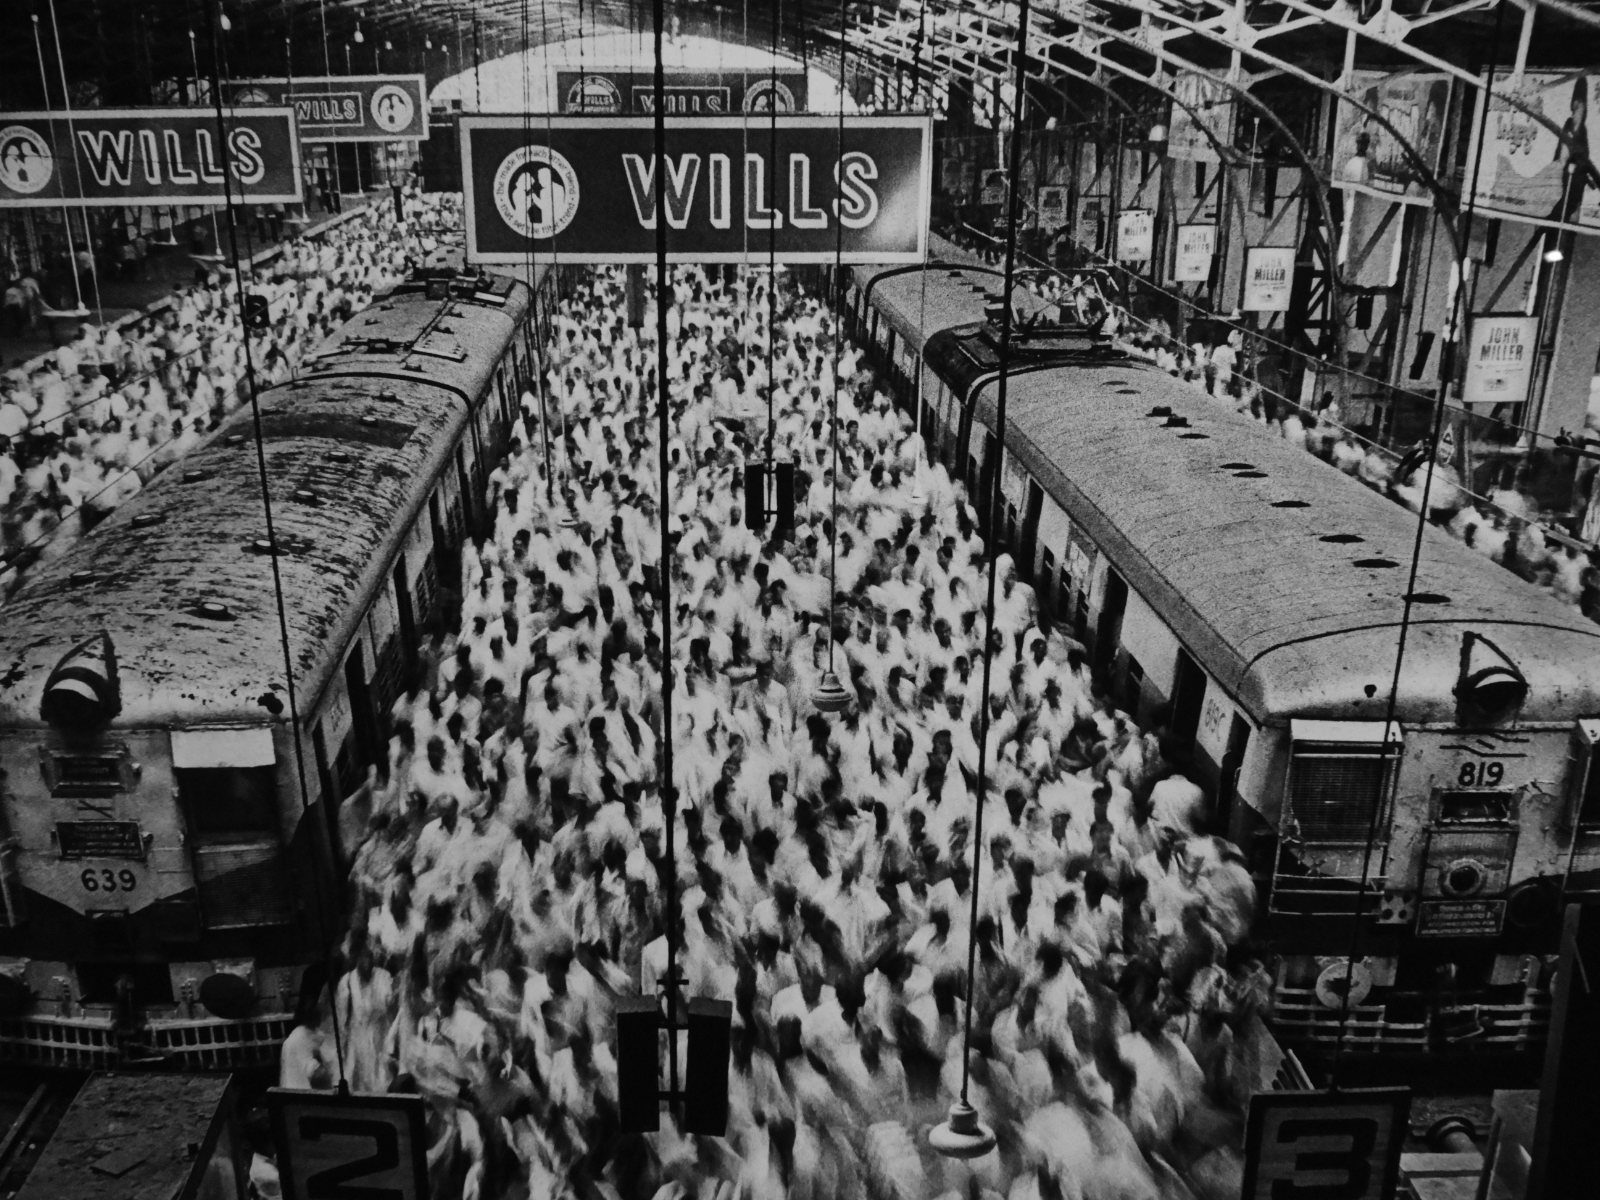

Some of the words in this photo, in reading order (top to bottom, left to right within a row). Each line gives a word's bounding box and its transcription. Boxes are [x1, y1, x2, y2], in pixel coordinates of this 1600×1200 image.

[296, 101, 357, 120] WILLS
[78, 127, 265, 185] WILLS
[621, 151, 879, 229] WILLS
[1254, 268, 1286, 281] MILLER
[1488, 328, 1520, 344] JOHN
[1480, 345, 1524, 361] MILLER
[1458, 761, 1504, 787] 819
[80, 868, 137, 892] 639
[299, 1116, 403, 1200] 2
[1271, 1119, 1379, 1200] 3
